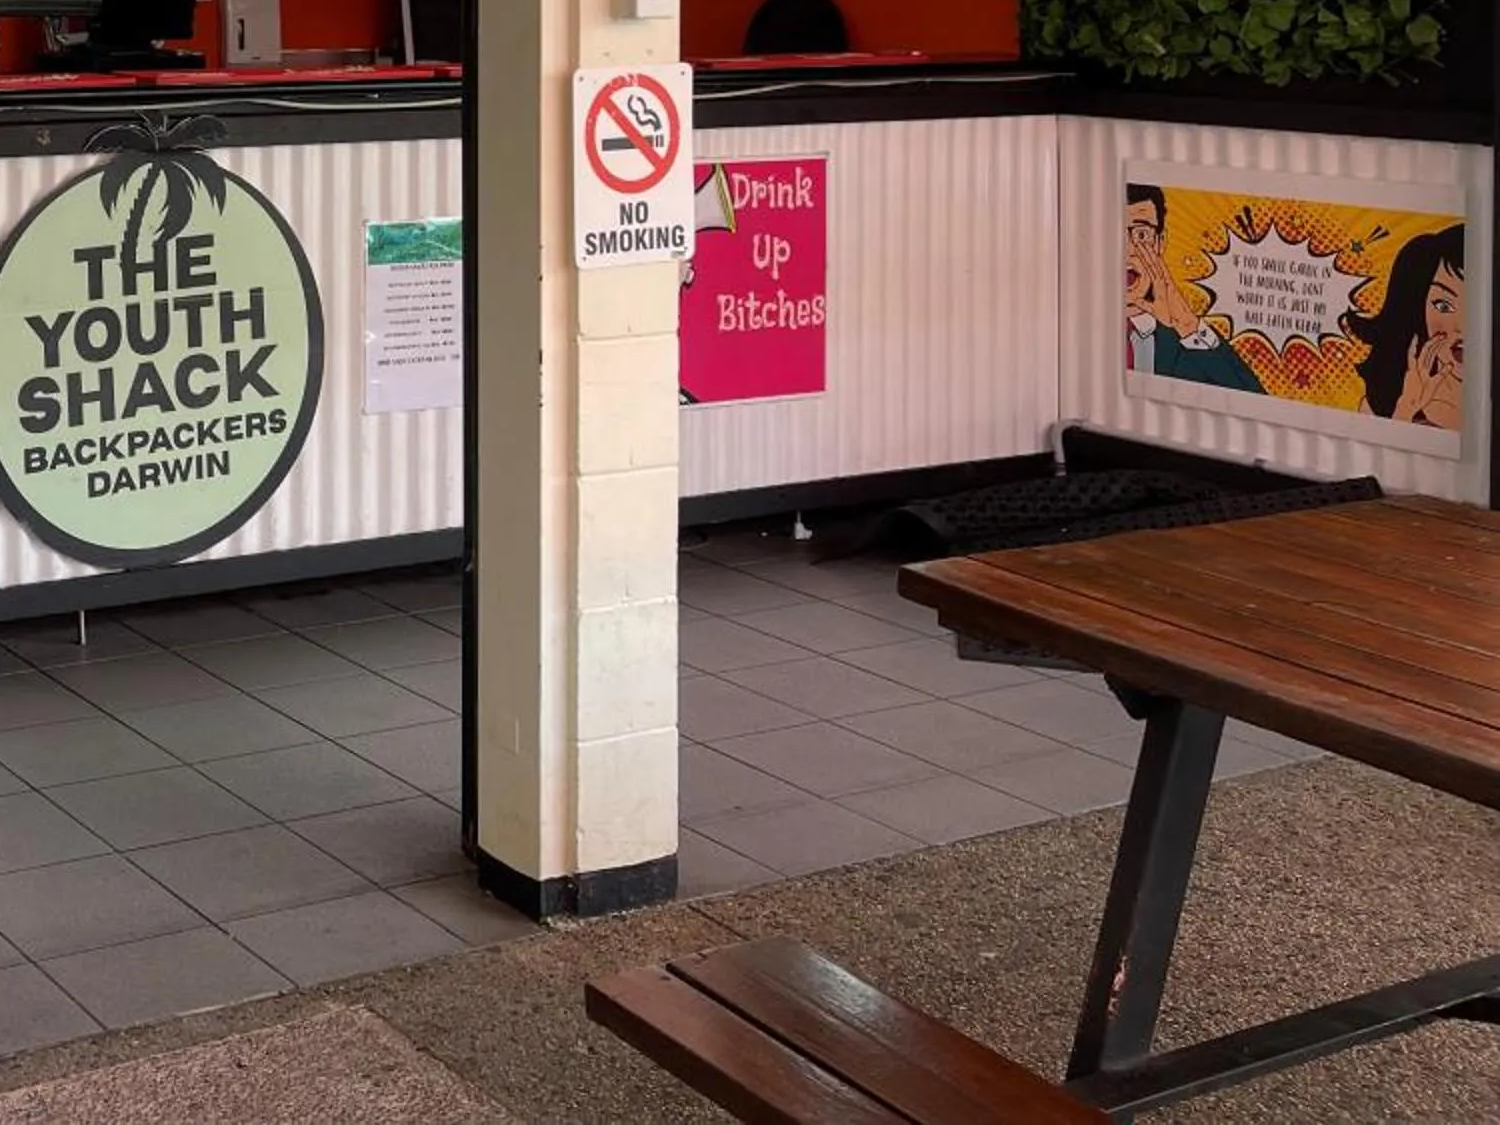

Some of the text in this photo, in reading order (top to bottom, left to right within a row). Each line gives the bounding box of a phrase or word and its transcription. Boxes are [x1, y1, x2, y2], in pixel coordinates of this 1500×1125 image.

[731, 167, 815, 210] Drink
[619, 201, 649, 226] NO
[585, 225, 685, 257] SMOKING
[752, 233, 791, 280] Up
[73, 233, 217, 301] THE
[24, 286, 266, 369] YOUTH
[717, 289, 825, 332] Bitches
[17, 344, 280, 434] SHACK
[23, 408, 288, 475] BACKPACKERS
[87, 450, 231, 499] DARWIN
